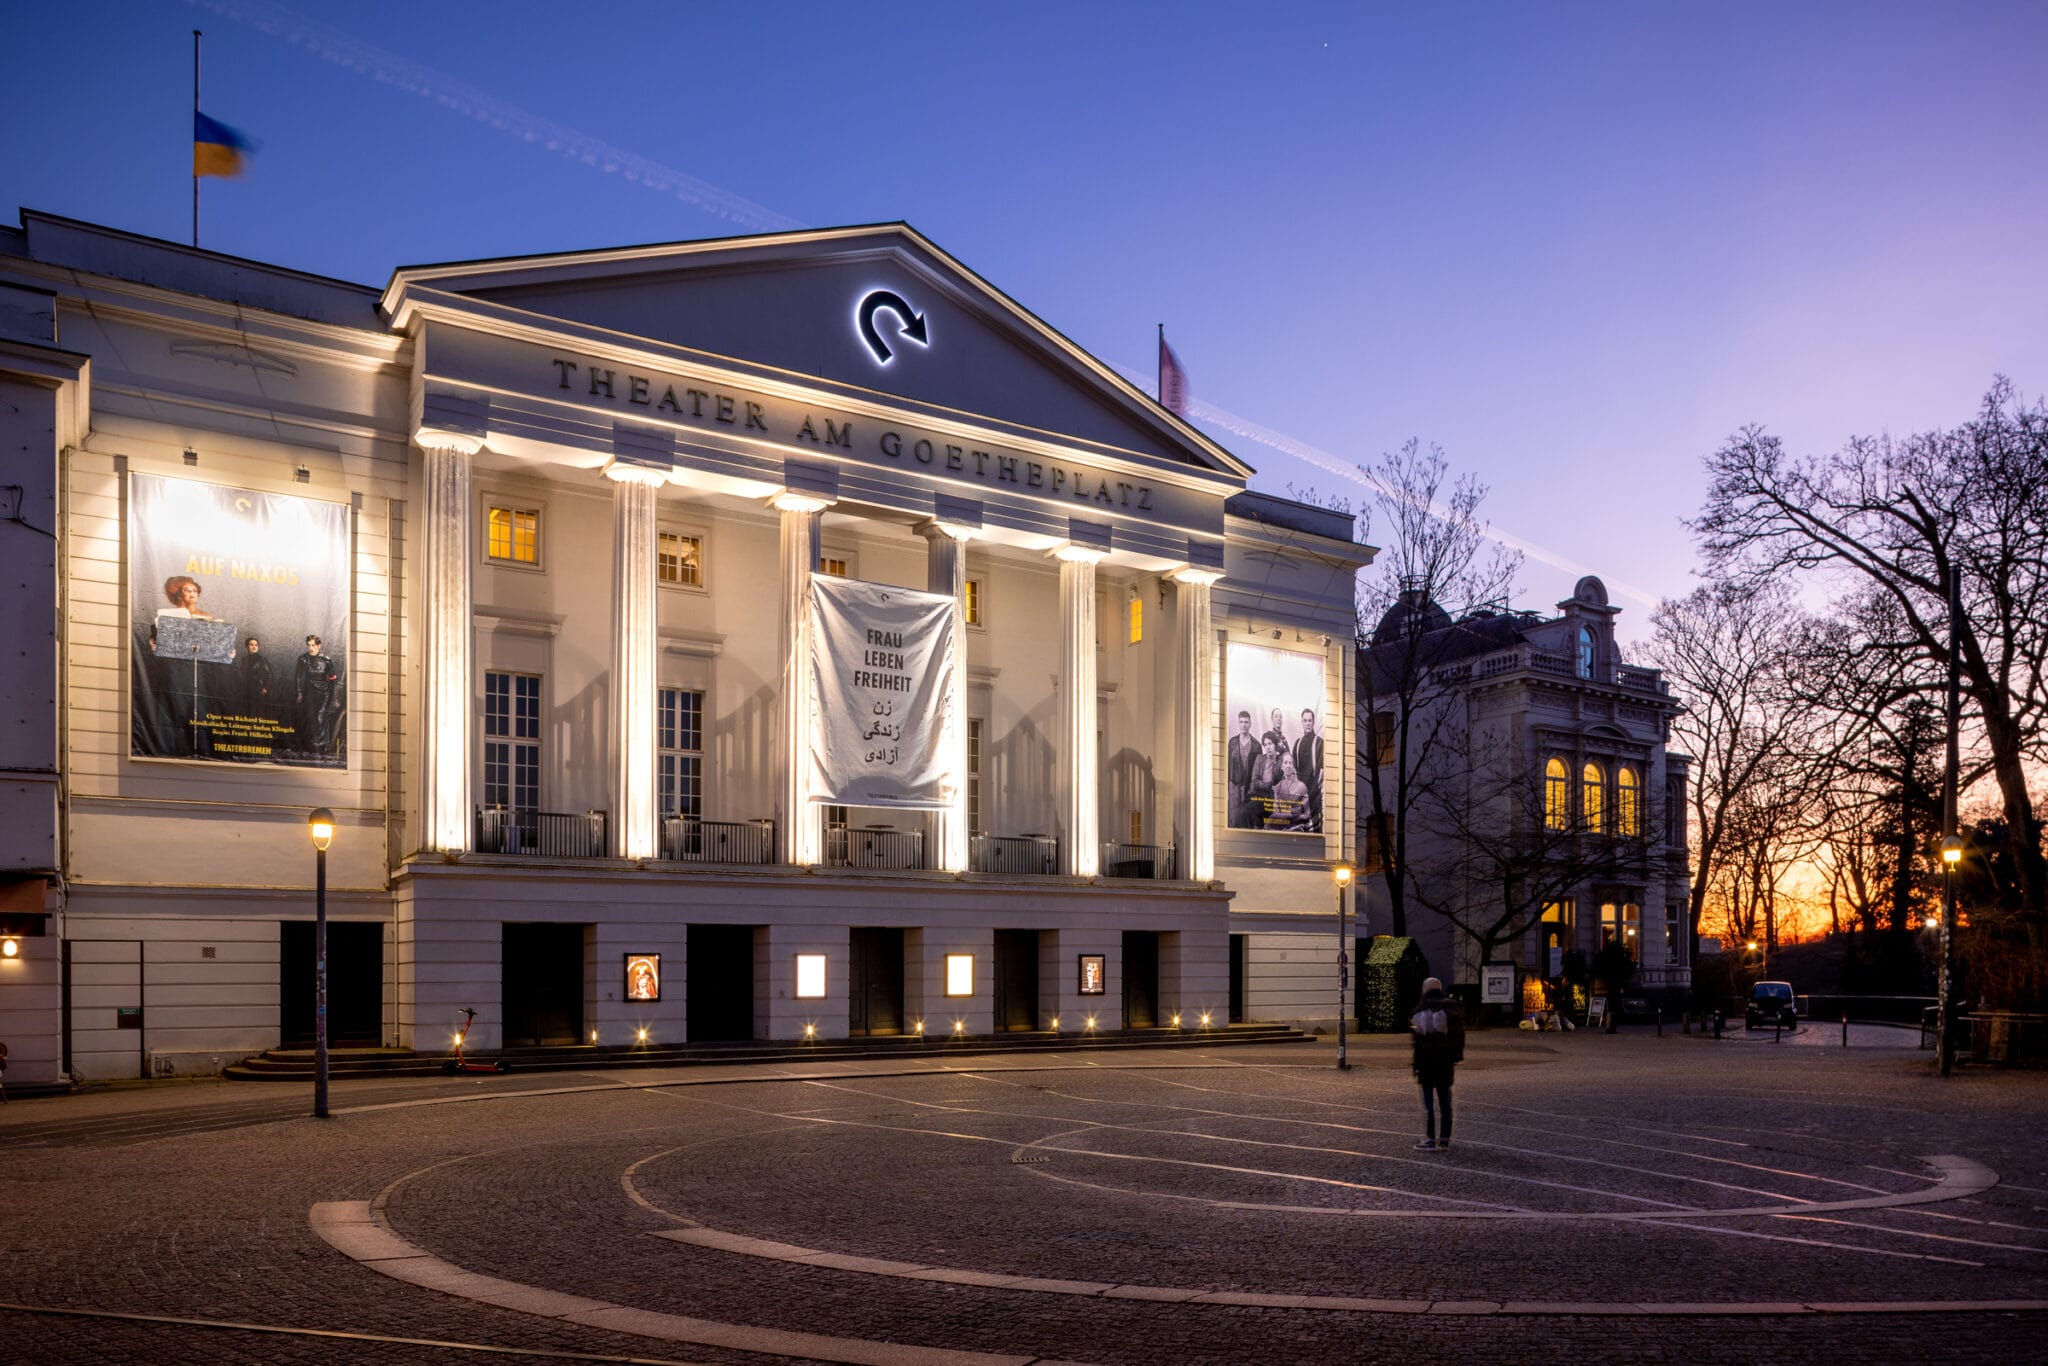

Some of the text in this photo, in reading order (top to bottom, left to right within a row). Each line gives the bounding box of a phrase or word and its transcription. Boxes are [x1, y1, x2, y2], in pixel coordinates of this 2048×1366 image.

[553, 358, 1153, 511] THEATER AM GOETHEPLATZ
[186, 554, 299, 586] AUF NAXOS
[867, 629, 902, 648] FRAU
[865, 650, 904, 670] LEBEN
[855, 671, 912, 692] FREIHEIT
[873, 701, 892, 716] زن
[214, 743, 272, 754] THEATERBREMEN
